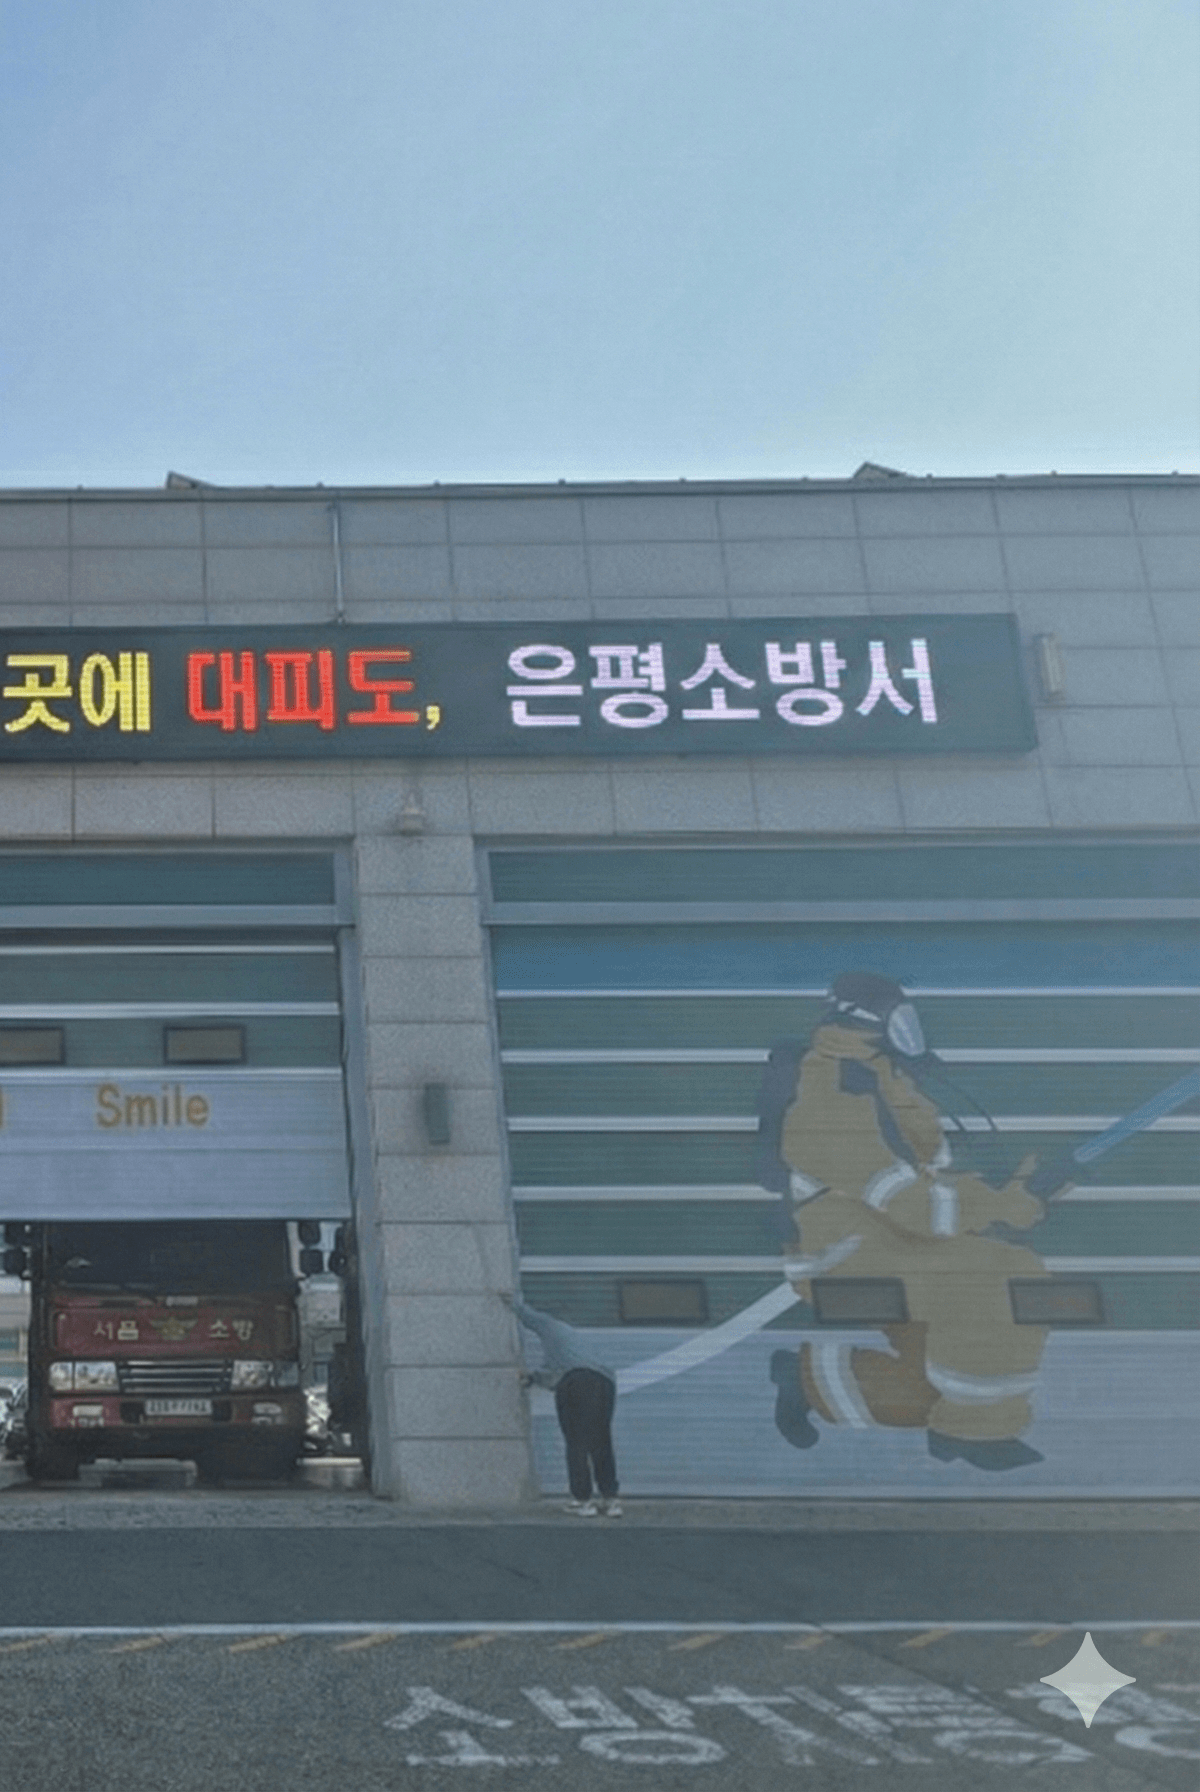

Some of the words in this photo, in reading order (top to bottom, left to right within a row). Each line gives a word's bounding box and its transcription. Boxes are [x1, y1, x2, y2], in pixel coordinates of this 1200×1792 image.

[3, 652, 152, 734] 곳에
[187, 650, 441, 731] 대피도,
[506, 637, 939, 729] 은평소방서
[95, 1082, 211, 1130] Smile
[208, 1318, 254, 1342] 소방
